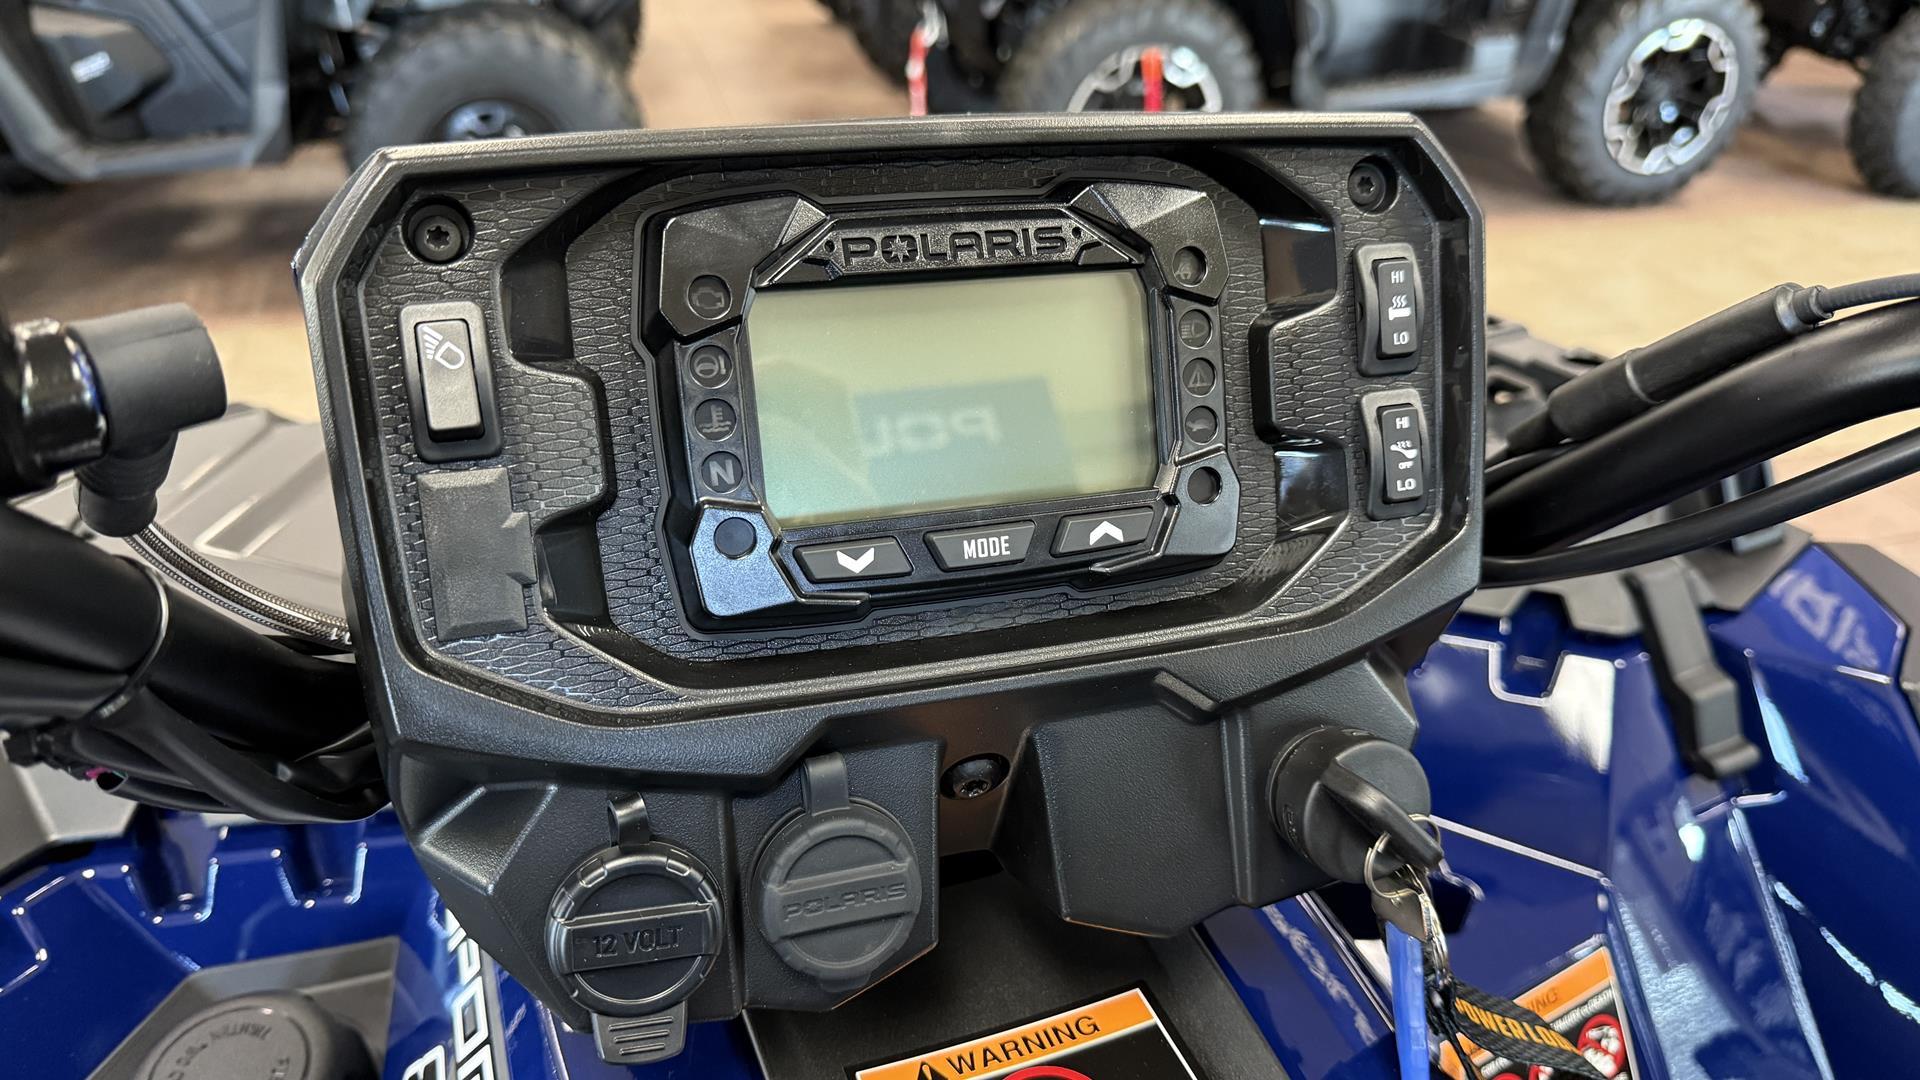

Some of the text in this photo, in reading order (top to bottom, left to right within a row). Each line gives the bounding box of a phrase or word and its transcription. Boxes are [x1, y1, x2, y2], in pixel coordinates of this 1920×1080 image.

[841, 226, 1068, 267] POLARIS
[1390, 269, 1406, 284] HI
[1393, 331, 1411, 345] LO
[1395, 416, 1411, 430] HI
[708, 459, 736, 487] N
[1398, 460, 1414, 470] OFF
[1396, 478, 1416, 492] LO
[962, 535, 1011, 560] MODE
[783, 883, 907, 922] POLARIS
[592, 925, 684, 958] 12 VOLT
[947, 1015, 1100, 1075] WARNING
